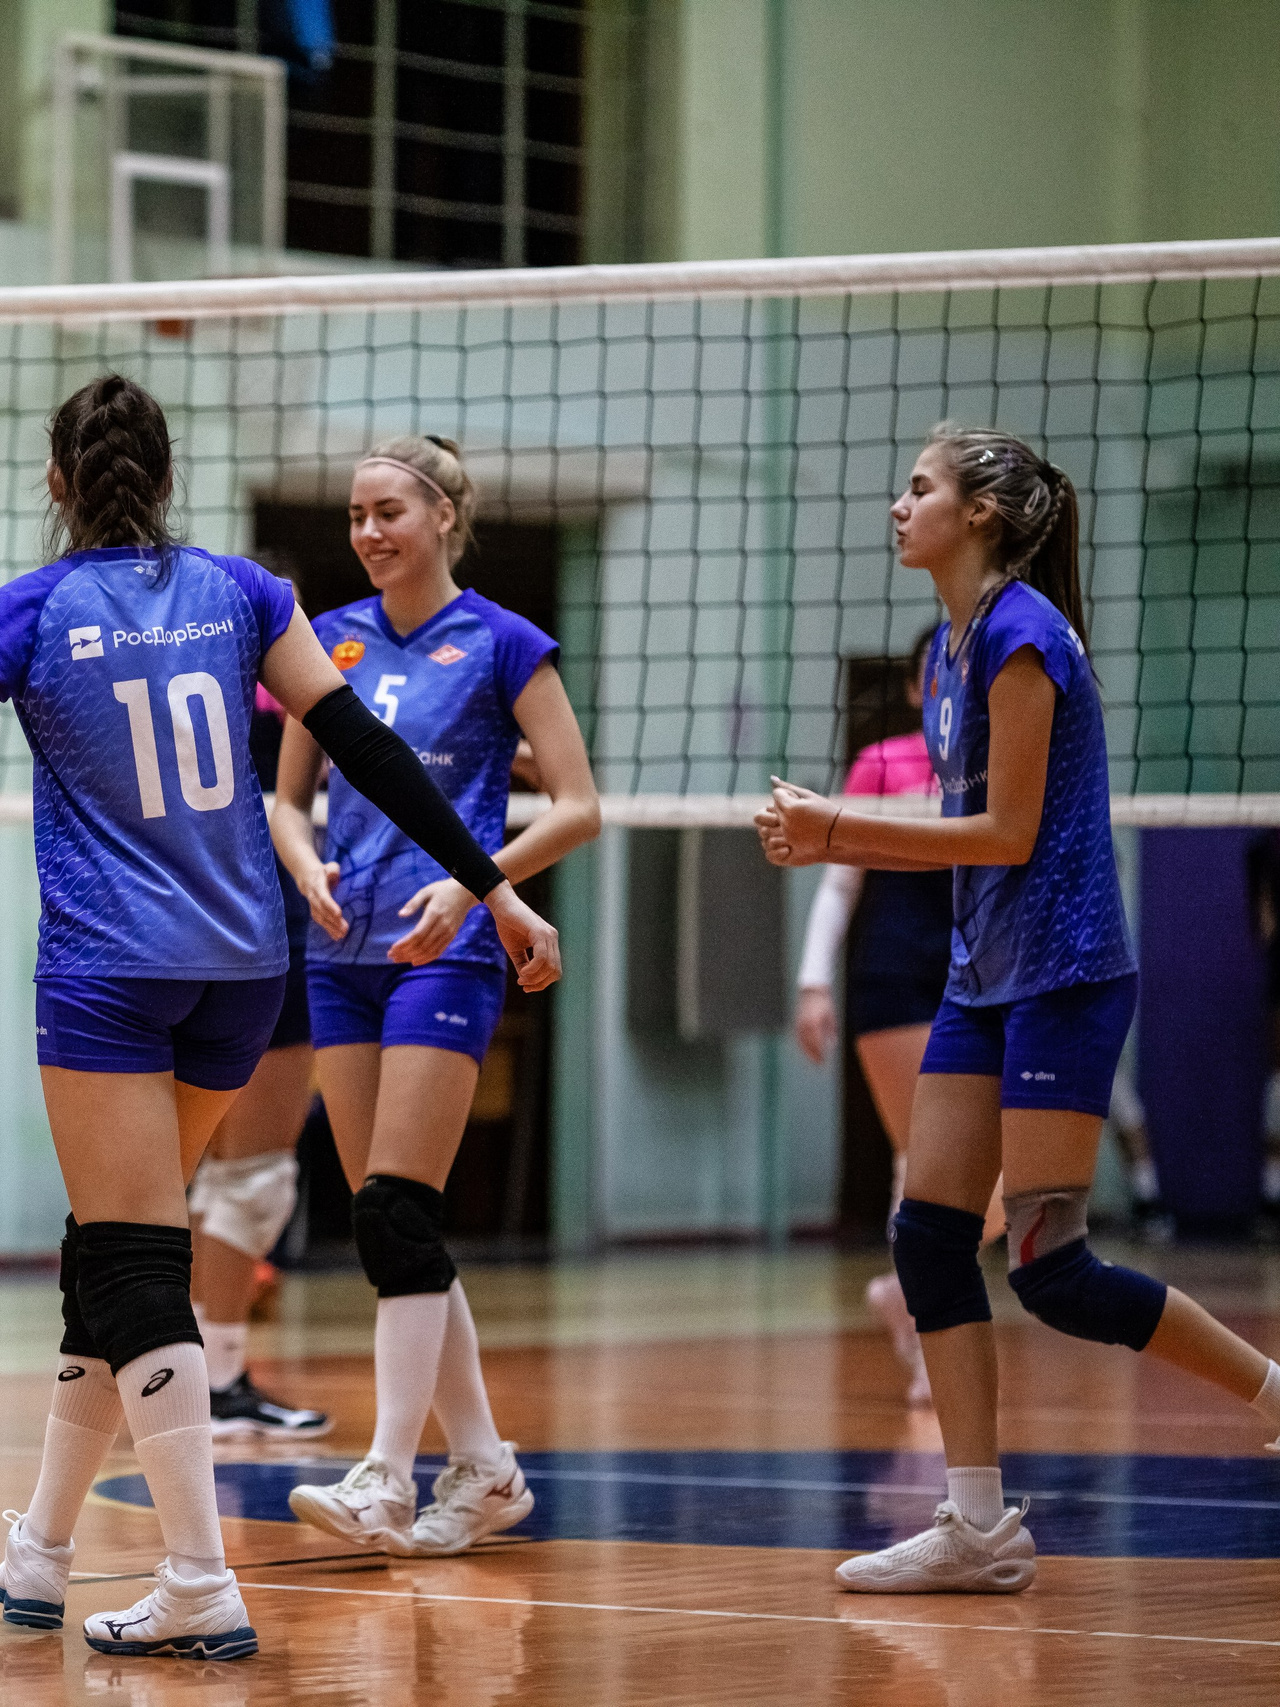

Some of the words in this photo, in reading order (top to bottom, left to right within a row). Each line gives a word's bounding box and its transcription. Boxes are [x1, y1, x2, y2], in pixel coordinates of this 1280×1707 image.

[373, 673, 407, 729] 5
[938, 697, 952, 762] 9
[113, 671, 234, 819] 10
